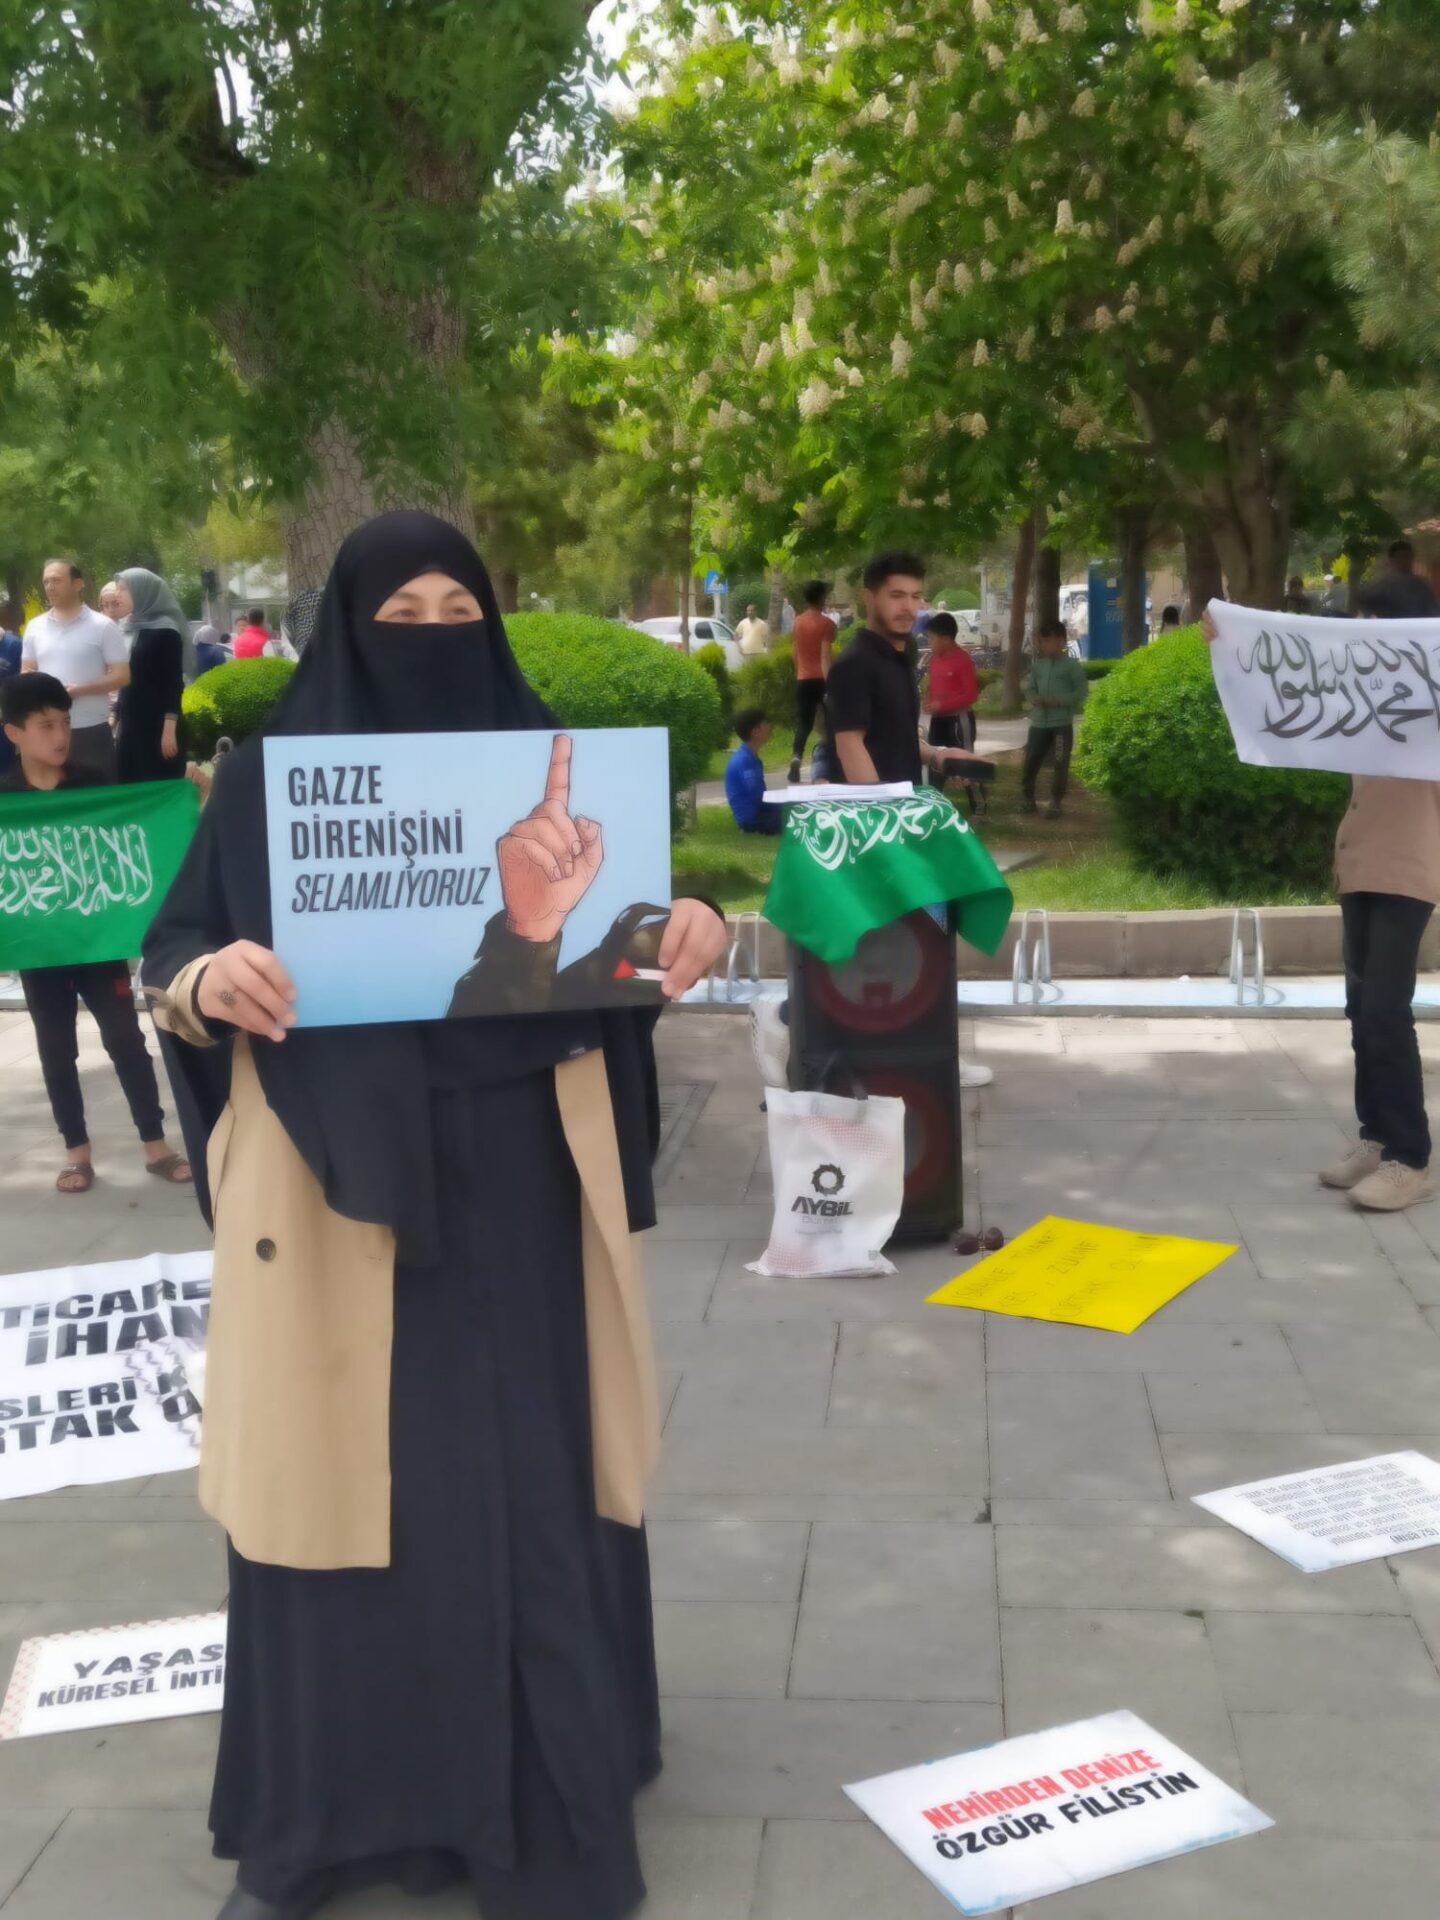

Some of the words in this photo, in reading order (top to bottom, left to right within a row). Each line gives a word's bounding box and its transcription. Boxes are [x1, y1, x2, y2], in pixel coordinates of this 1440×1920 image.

[287, 765, 383, 807] GAZZE
[290, 808, 463, 869] DİRENİŞİNİ
[291, 866, 491, 914] SELAMLIYORUZ
[0, 1404, 140, 1450] TAK
[37, 1677, 160, 1708] KÜRESEL
[922, 1774, 1067, 1831] NEHİRDEN
[1061, 1748, 1163, 1794] DENİZE
[932, 1813, 1055, 1860] ÖZGÜR
[1058, 1771, 1200, 1824] FİLİSTİN
